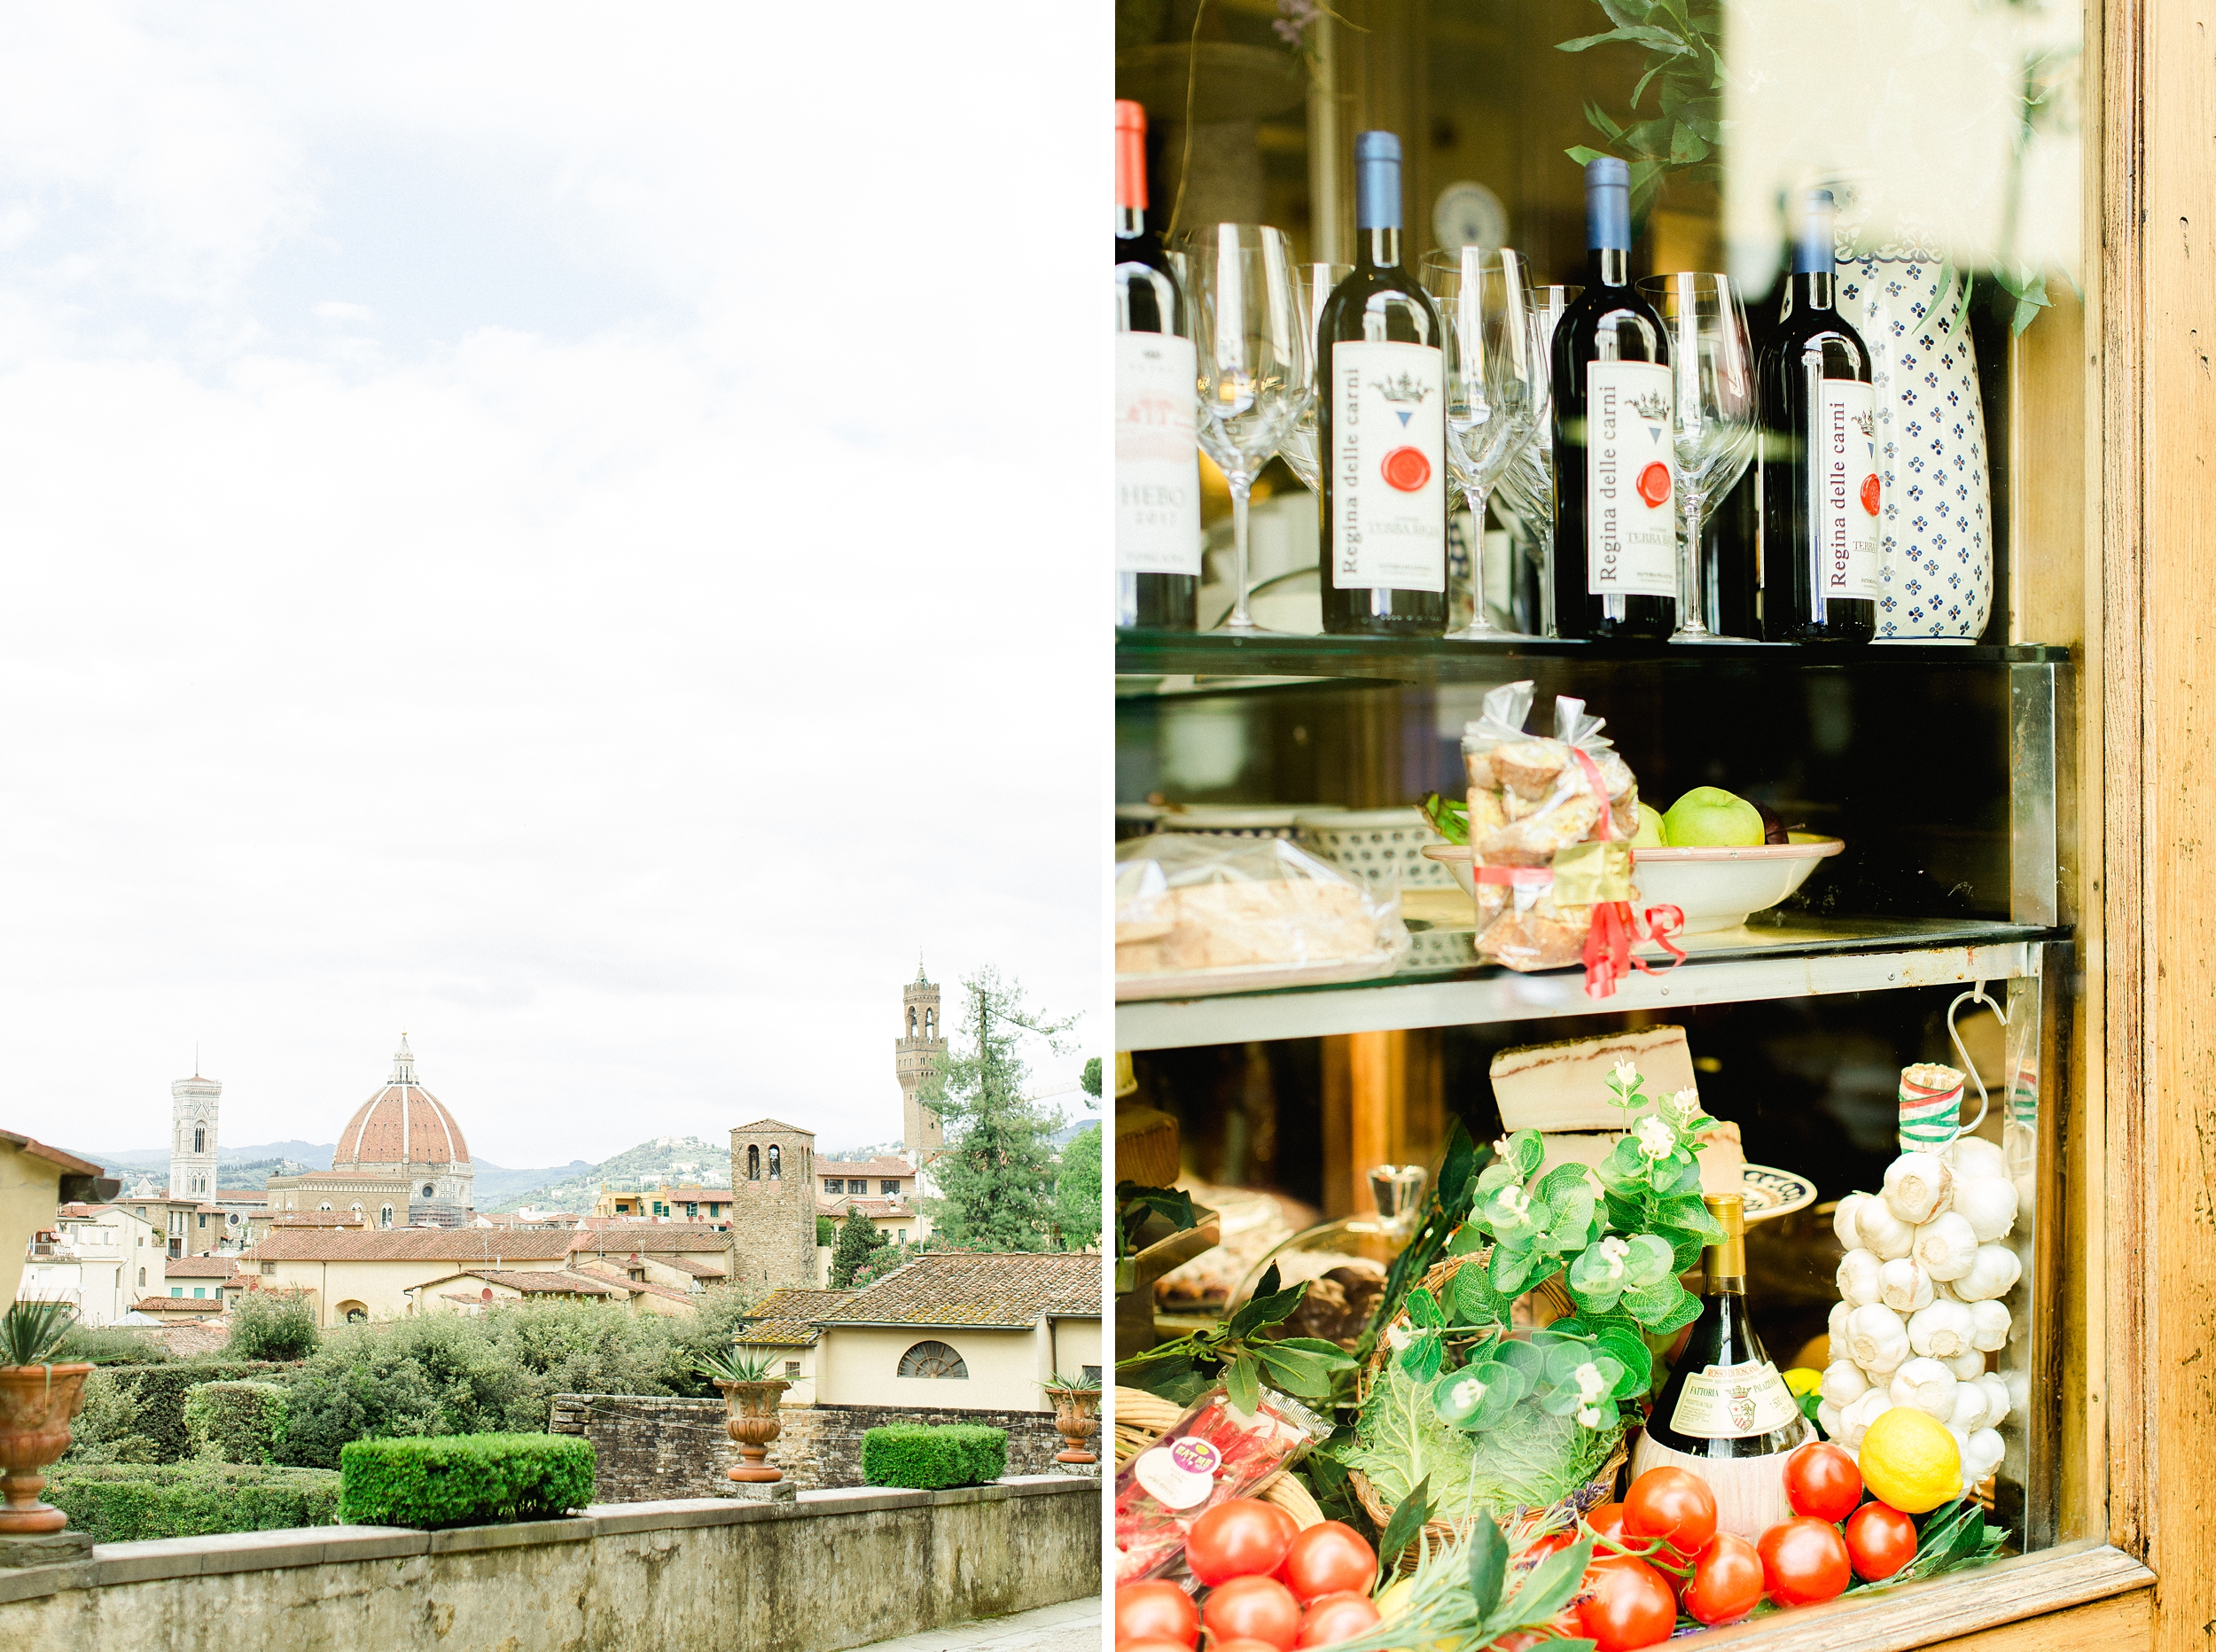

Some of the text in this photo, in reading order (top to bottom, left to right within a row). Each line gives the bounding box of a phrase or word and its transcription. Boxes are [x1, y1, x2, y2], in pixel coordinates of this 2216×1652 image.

[1343, 368, 1362, 574] Regina delle carni
[1599, 386, 1621, 581] Regina delle carni
[1830, 402, 1850, 588] Regina delle carni
[1627, 532, 1662, 544] TERRA
[1689, 1385, 1720, 1398] FATTORIA
[1707, 1365, 1760, 1378] ROSSO DI TOSCANA
